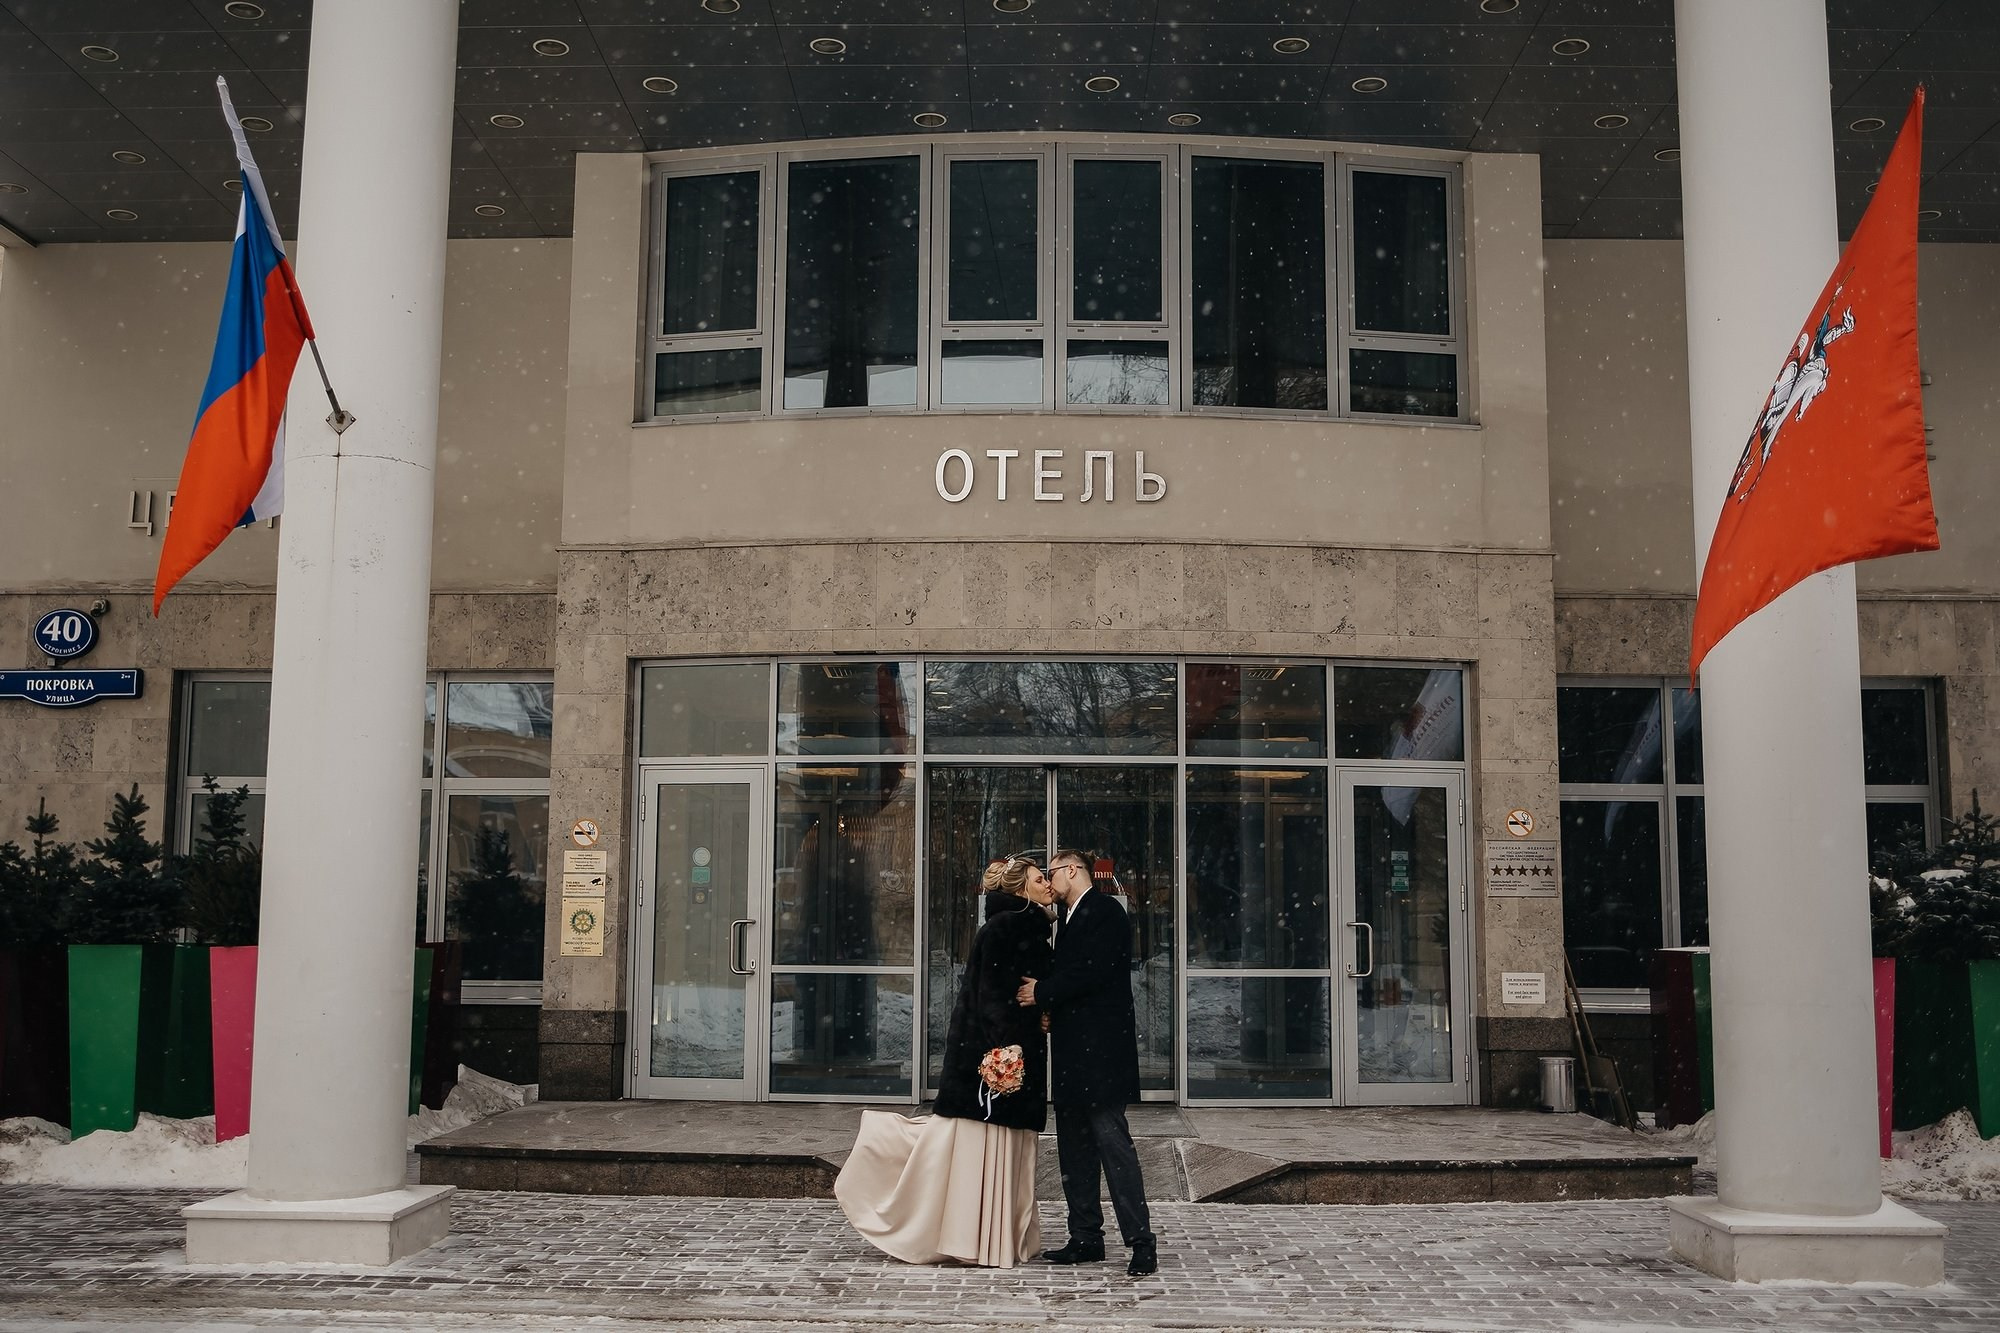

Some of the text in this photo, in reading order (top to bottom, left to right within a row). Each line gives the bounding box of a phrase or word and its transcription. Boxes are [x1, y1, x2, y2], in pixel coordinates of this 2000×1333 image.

[935, 448, 1168, 503] ОТЕЛЬ
[42, 616, 82, 642] 40
[44, 643, 76, 654] СТРОЕНИЕ
[26, 679, 94, 691] ПОКРОВКА
[46, 695, 75, 703] УЛИЦА
[1094, 871, 1113, 879] mm
